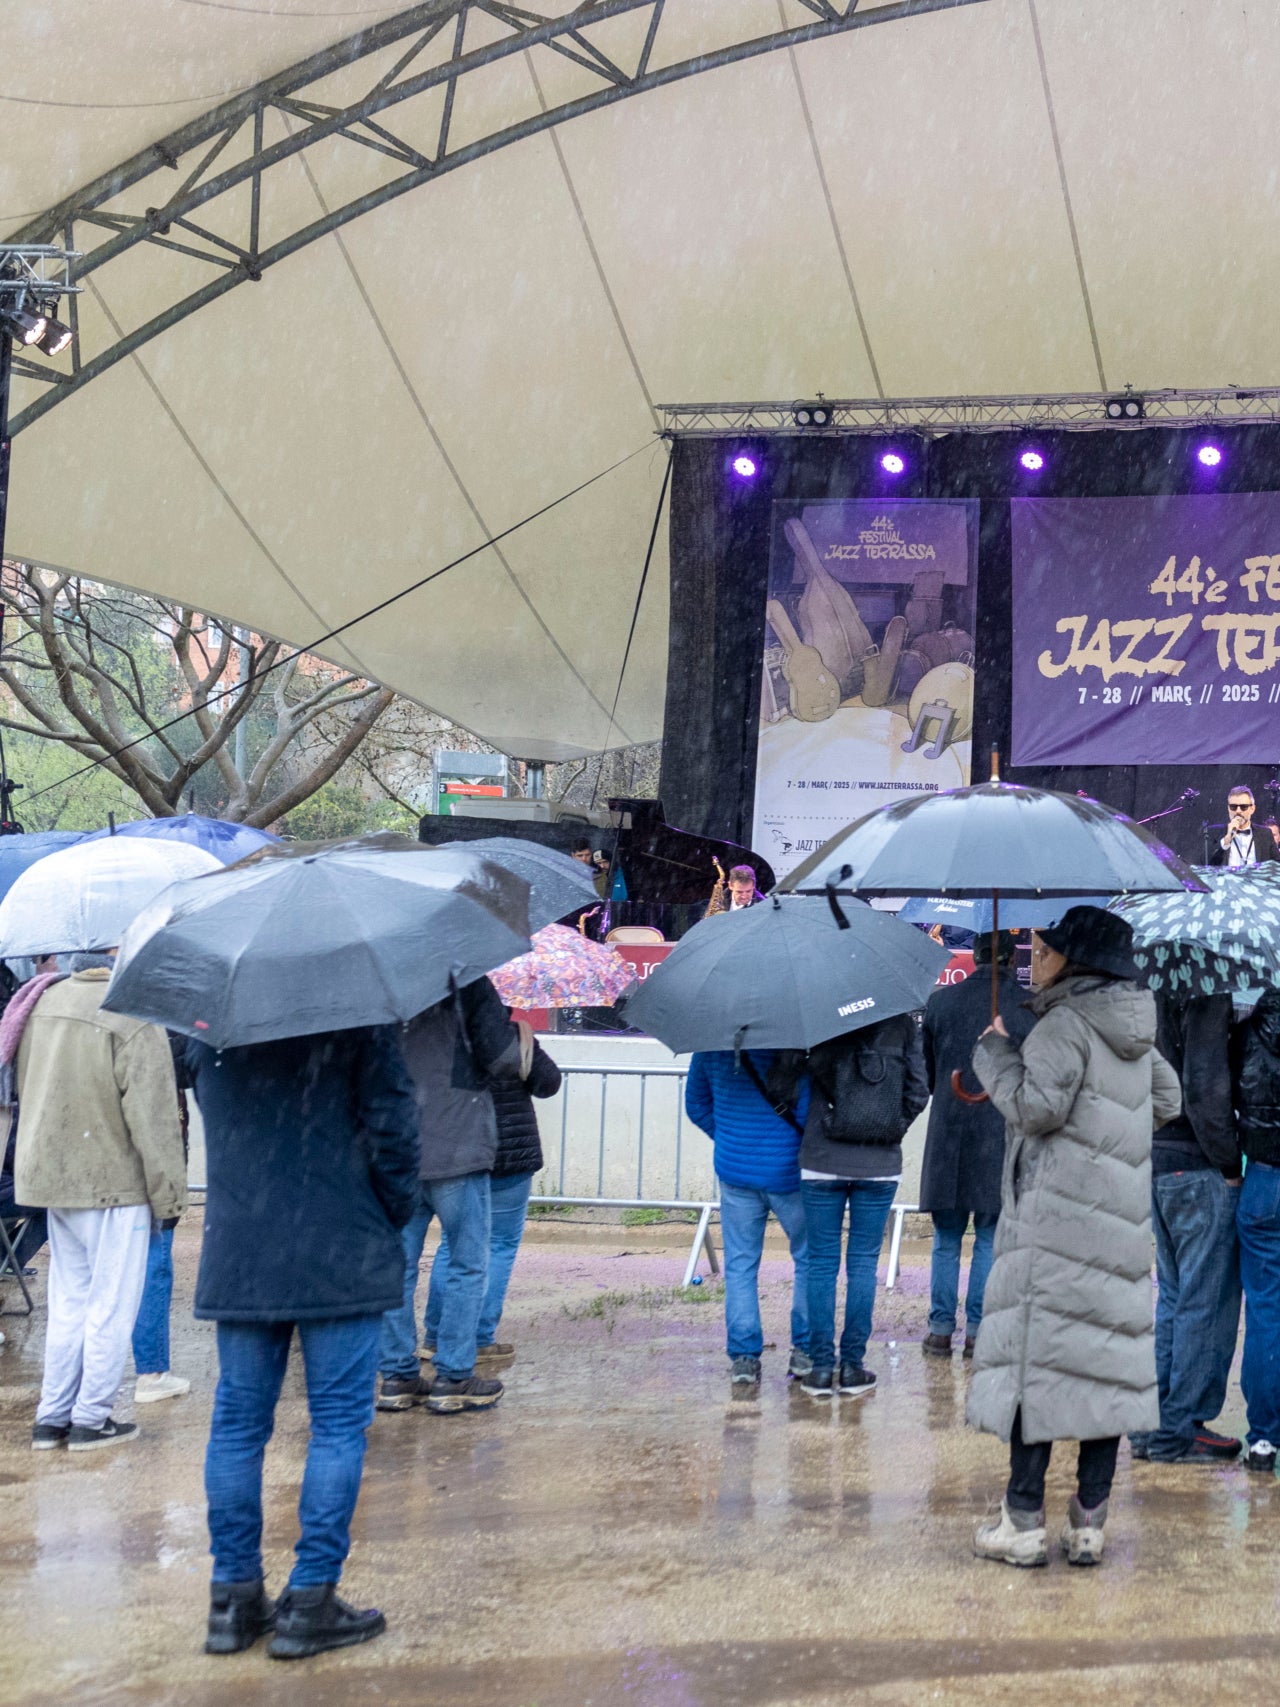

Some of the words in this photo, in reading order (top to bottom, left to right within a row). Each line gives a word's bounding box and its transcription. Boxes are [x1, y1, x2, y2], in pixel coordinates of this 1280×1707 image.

[858, 530, 905, 545] FESTIVAL
[824, 544, 862, 560] JAZZ
[863, 543, 936, 560] TERRASSA
[1038, 613, 1194, 683] JAZZ
[1078, 687, 1087, 704] 7
[1102, 687, 1122, 704] 28
[1151, 685, 1192, 706] MARÇ
[1222, 684, 1260, 702] 2025
[797, 780, 806, 789] 28
[811, 780, 828, 791] MARÇ
[834, 781, 850, 789] 2025
[858, 782, 939, 791] WWW.JAZZTERRASSA.ORG
[795, 839, 813, 851] JAZZ
[837, 997, 876, 1017] INESIS
